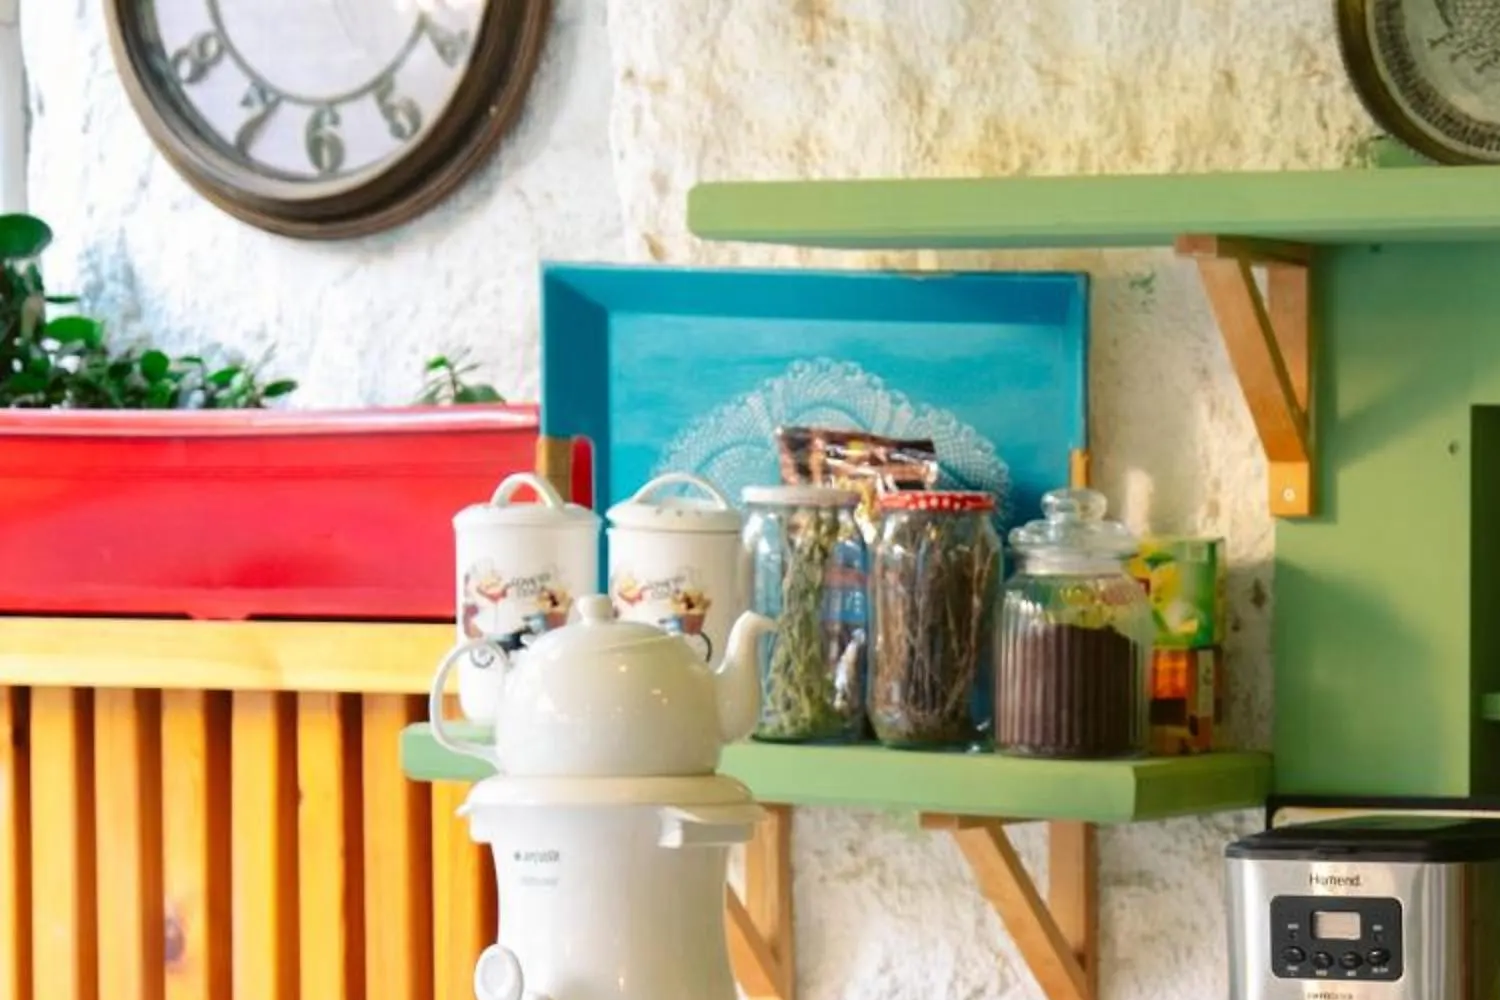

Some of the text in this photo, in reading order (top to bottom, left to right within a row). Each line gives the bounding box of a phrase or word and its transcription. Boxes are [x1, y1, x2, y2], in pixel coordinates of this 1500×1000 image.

[172, 30, 226, 84] 8
[235, 78, 283, 159] 7
[305, 104, 345, 174] 6
